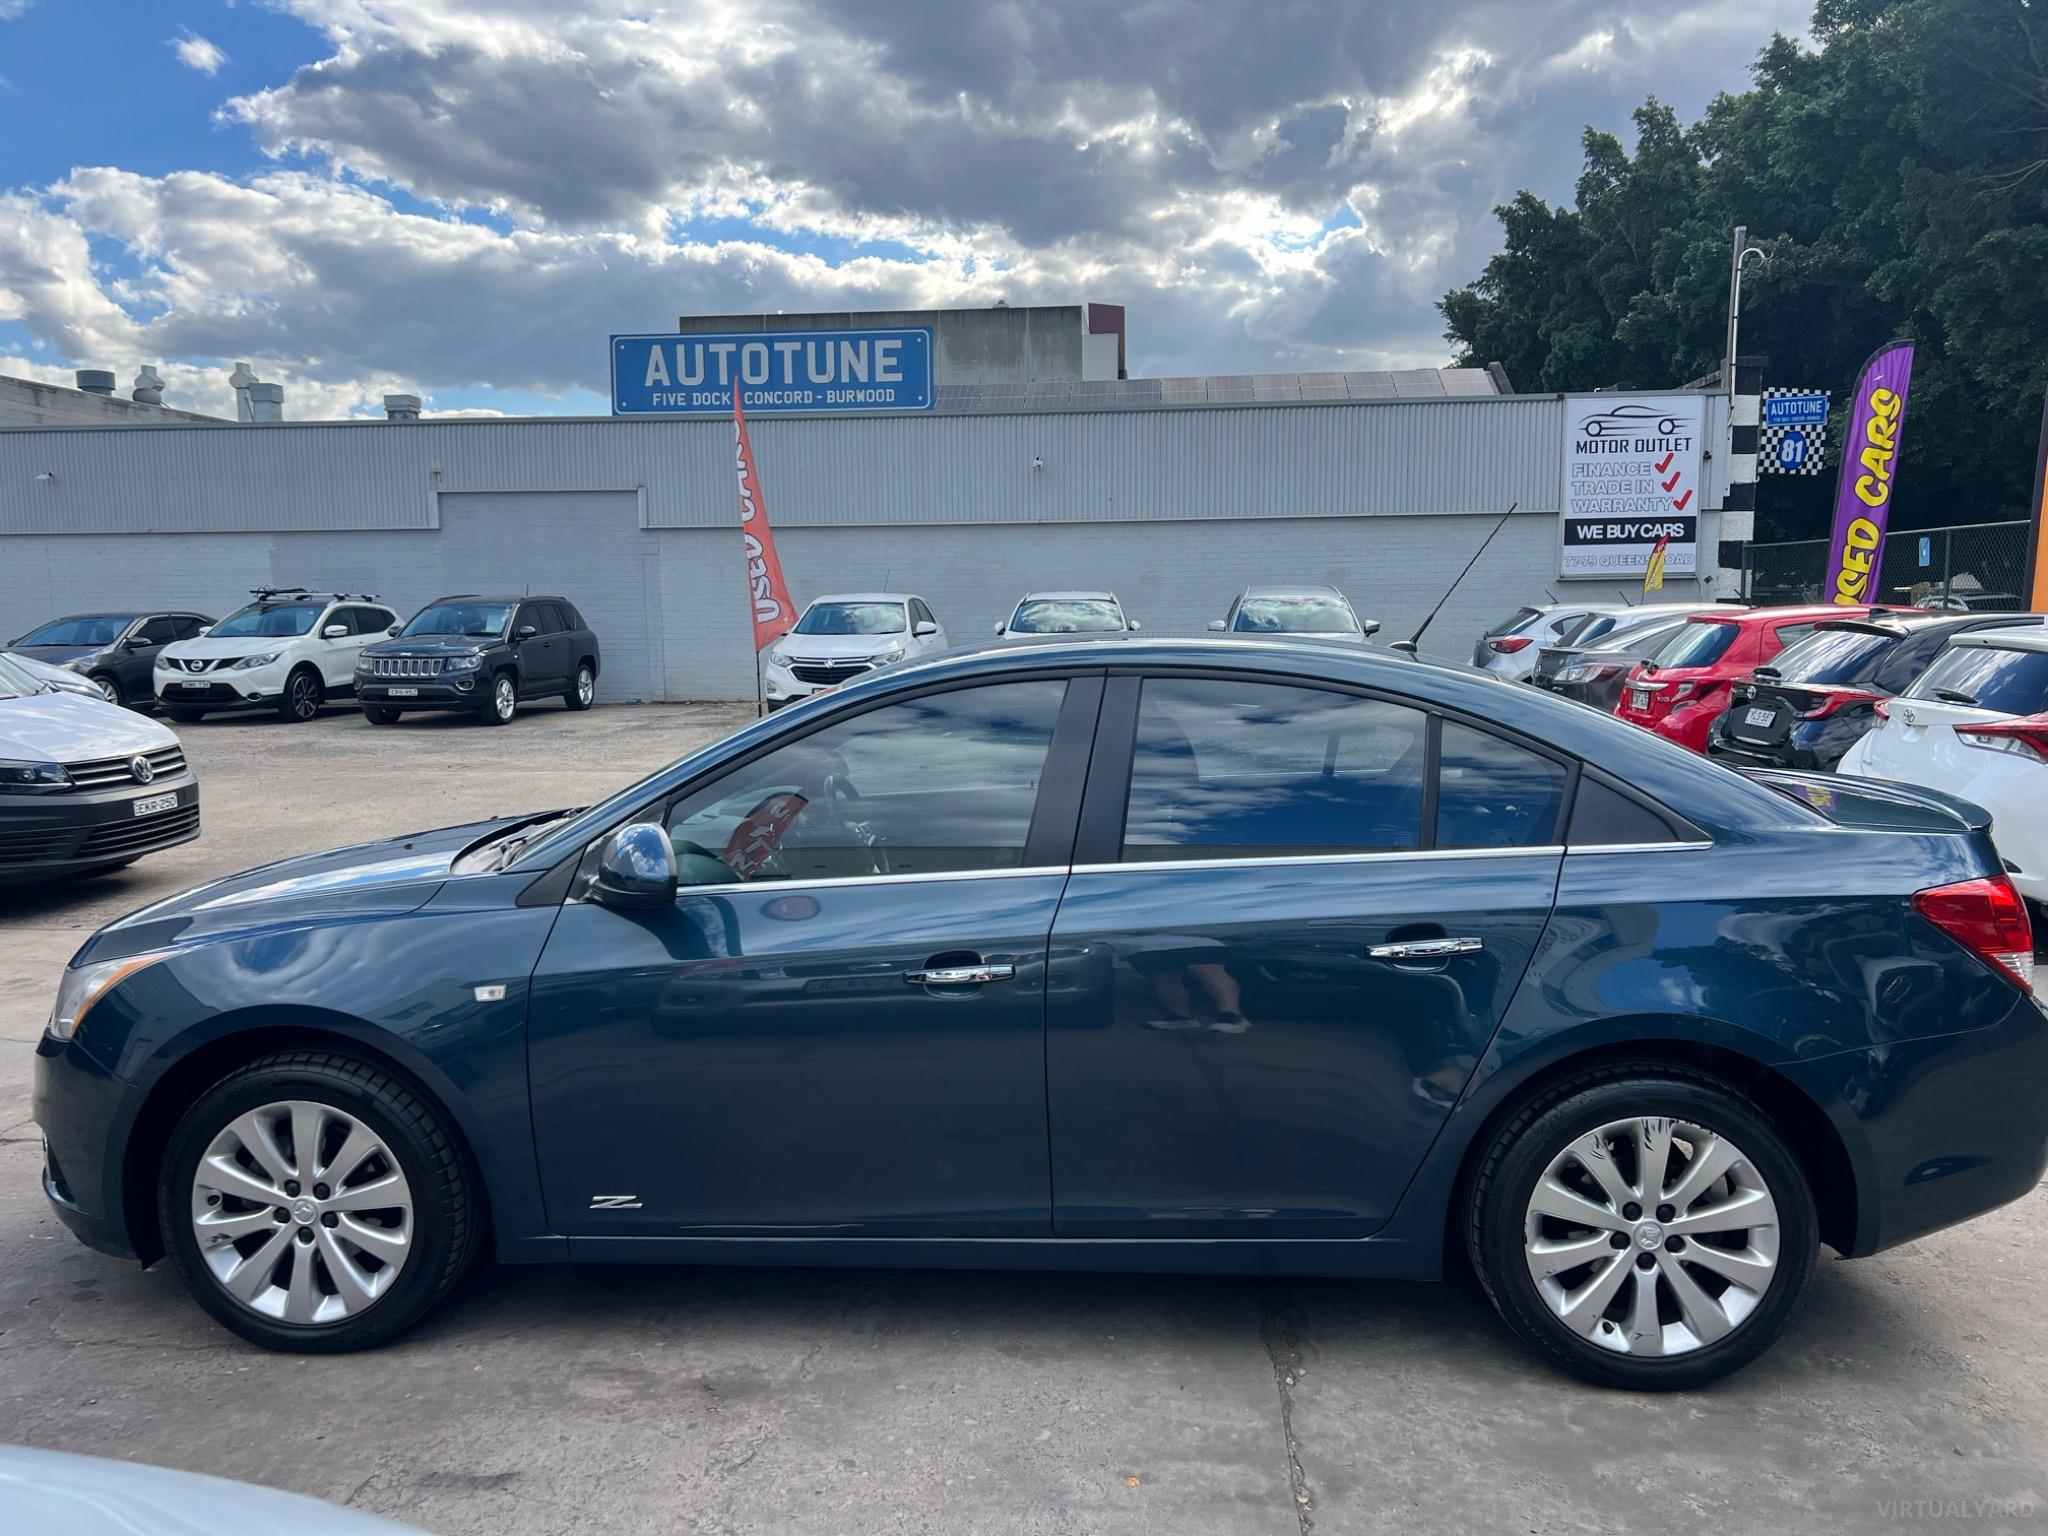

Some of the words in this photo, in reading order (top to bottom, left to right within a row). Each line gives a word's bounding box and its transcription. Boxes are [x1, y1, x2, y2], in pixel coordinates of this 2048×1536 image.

[644, 339, 903, 386] AUTOTUNE
[652, 392, 687, 406] FIVE
[692, 391, 731, 405] DOCK
[744, 390, 813, 404] CONCORD
[826, 388, 895, 403] BURWOOD
[1771, 400, 1823, 416] AUTOTUNE
[1576, 439, 1629, 454] MOTOR
[1634, 437, 1693, 453] OUTLET
[1781, 439, 1804, 462] 81
[1854, 387, 1902, 507] CARS
[1571, 461, 1652, 478] FINANCE
[1571, 479, 1632, 496] TRADE
[1635, 479, 1655, 495] IN
[1571, 496, 1673, 514] WARRANTY
[1576, 525, 1604, 539] WE
[1606, 524, 1640, 538] BUY
[1640, 523, 1685, 538] CARS
[1664, 553, 1695, 566] OAD
